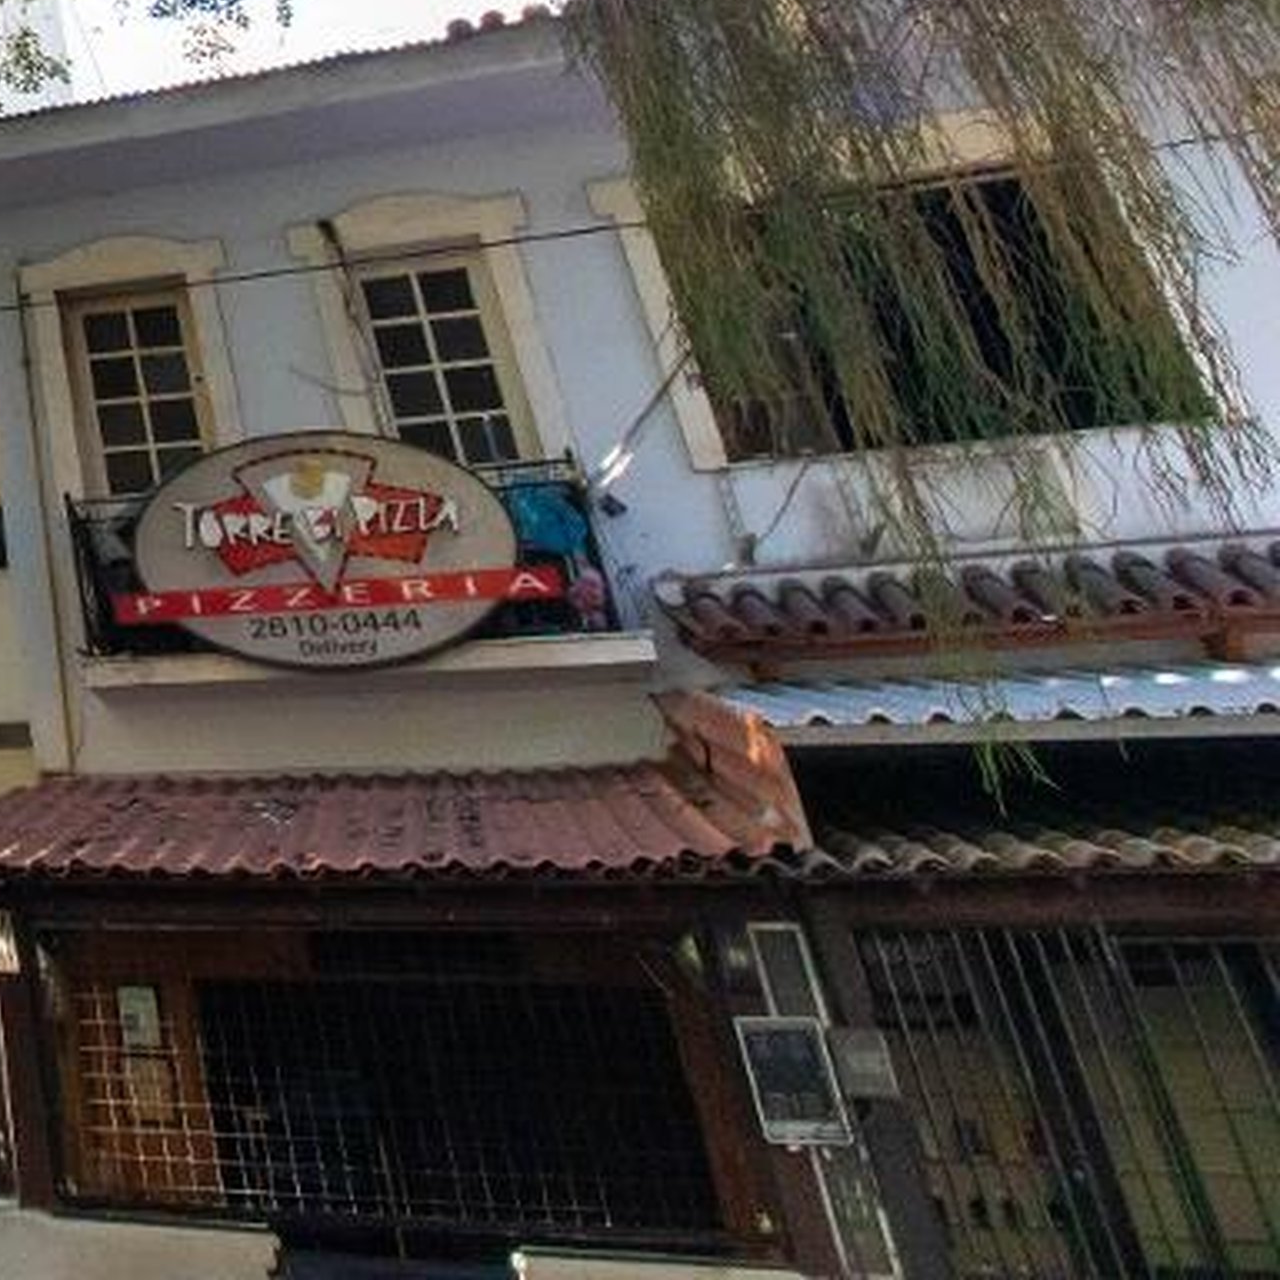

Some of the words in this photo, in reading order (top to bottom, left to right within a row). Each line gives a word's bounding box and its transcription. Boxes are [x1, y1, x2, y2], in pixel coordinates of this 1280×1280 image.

[172, 502, 294, 548] TORRE
[350, 495, 459, 537] PIZZA
[137, 571, 549, 615] PIZZERIA
